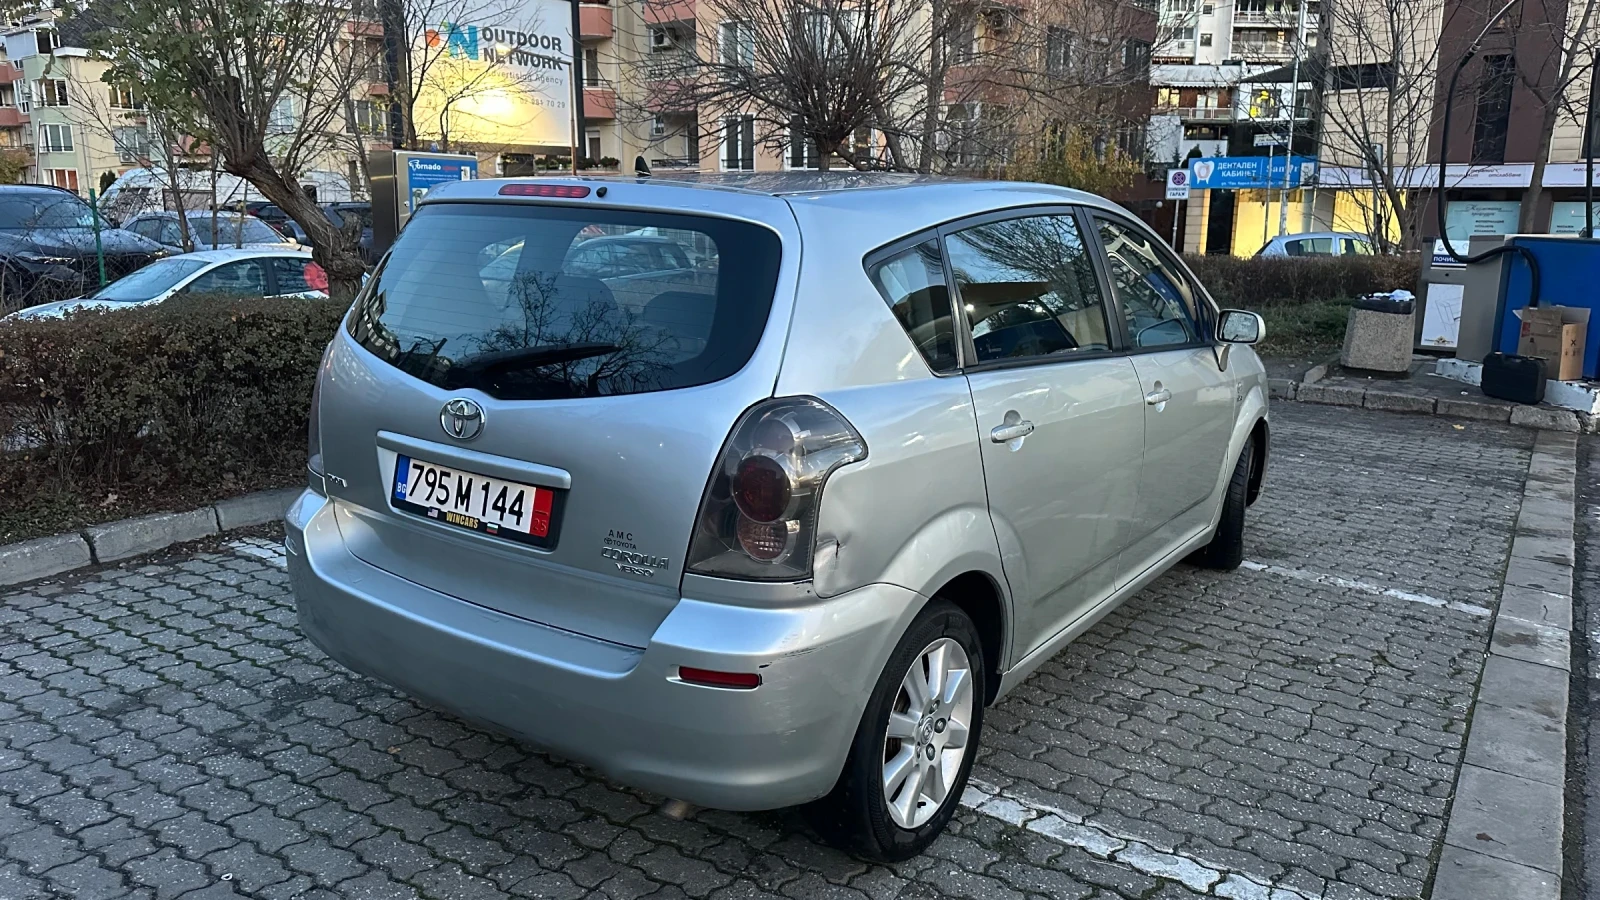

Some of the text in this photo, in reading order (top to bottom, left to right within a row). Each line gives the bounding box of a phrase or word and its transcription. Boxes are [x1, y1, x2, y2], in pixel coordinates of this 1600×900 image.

[482, 26, 562, 51] OUTDOOR
[535, 73, 564, 86] Agency
[1217, 161, 1257, 170] ДЕНТАЛЕН
[397, 481, 407, 494] BG
[409, 463, 525, 527] 795 M 144
[446, 511, 479, 529] WINCARS
[612, 539, 637, 550] TOYOTA
[601, 546, 670, 570] COROLLA
[615, 562, 654, 577] VERSO
